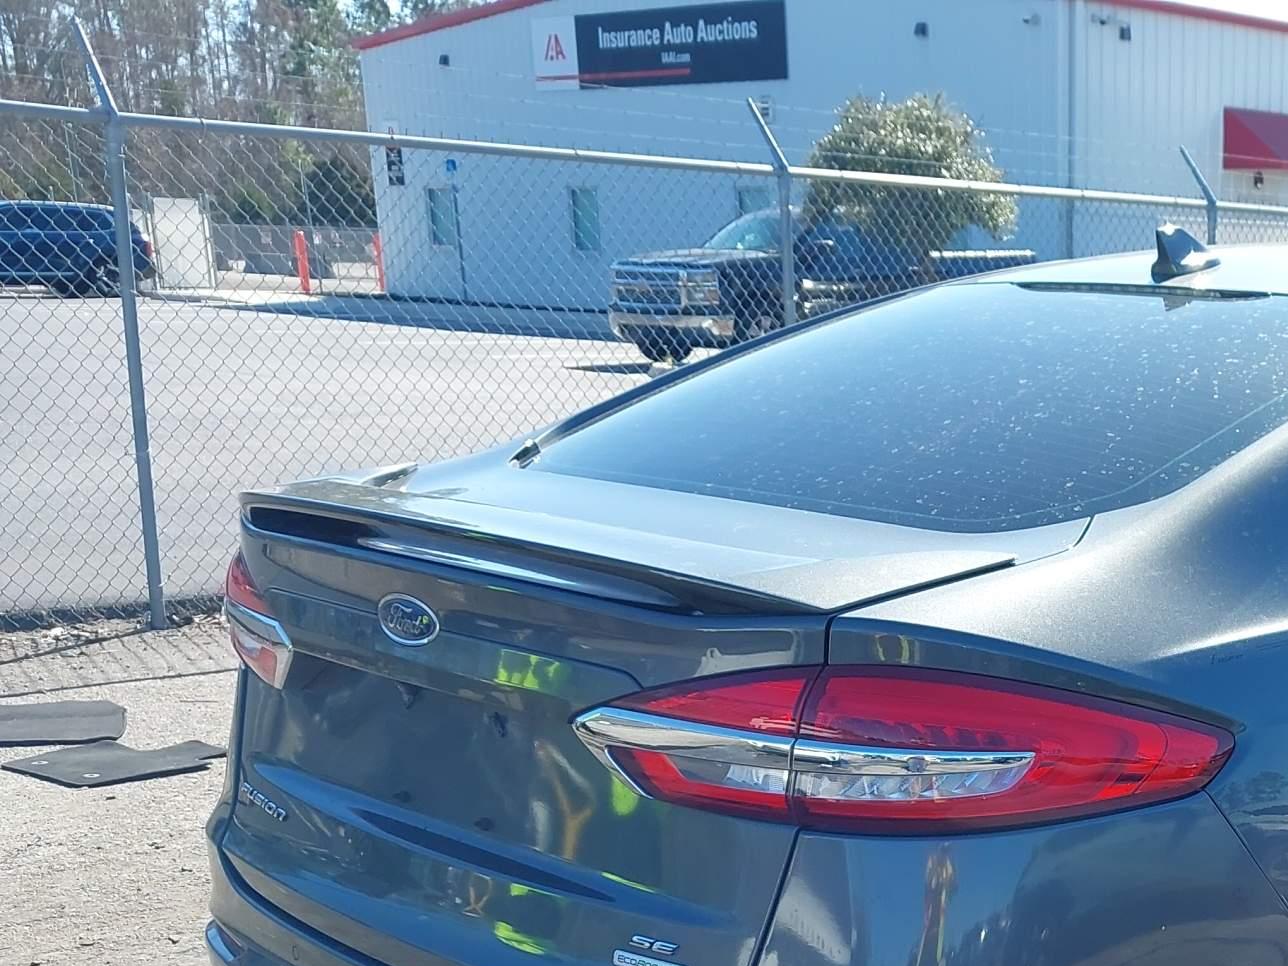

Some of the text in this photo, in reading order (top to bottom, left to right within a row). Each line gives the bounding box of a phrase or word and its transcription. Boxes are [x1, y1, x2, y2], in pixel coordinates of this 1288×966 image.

[598, 17, 758, 49] Insurance Auto Auctions
[384, 603, 426, 634] Ford
[241, 782, 287, 821] FUSION
[628, 935, 680, 955] SE
